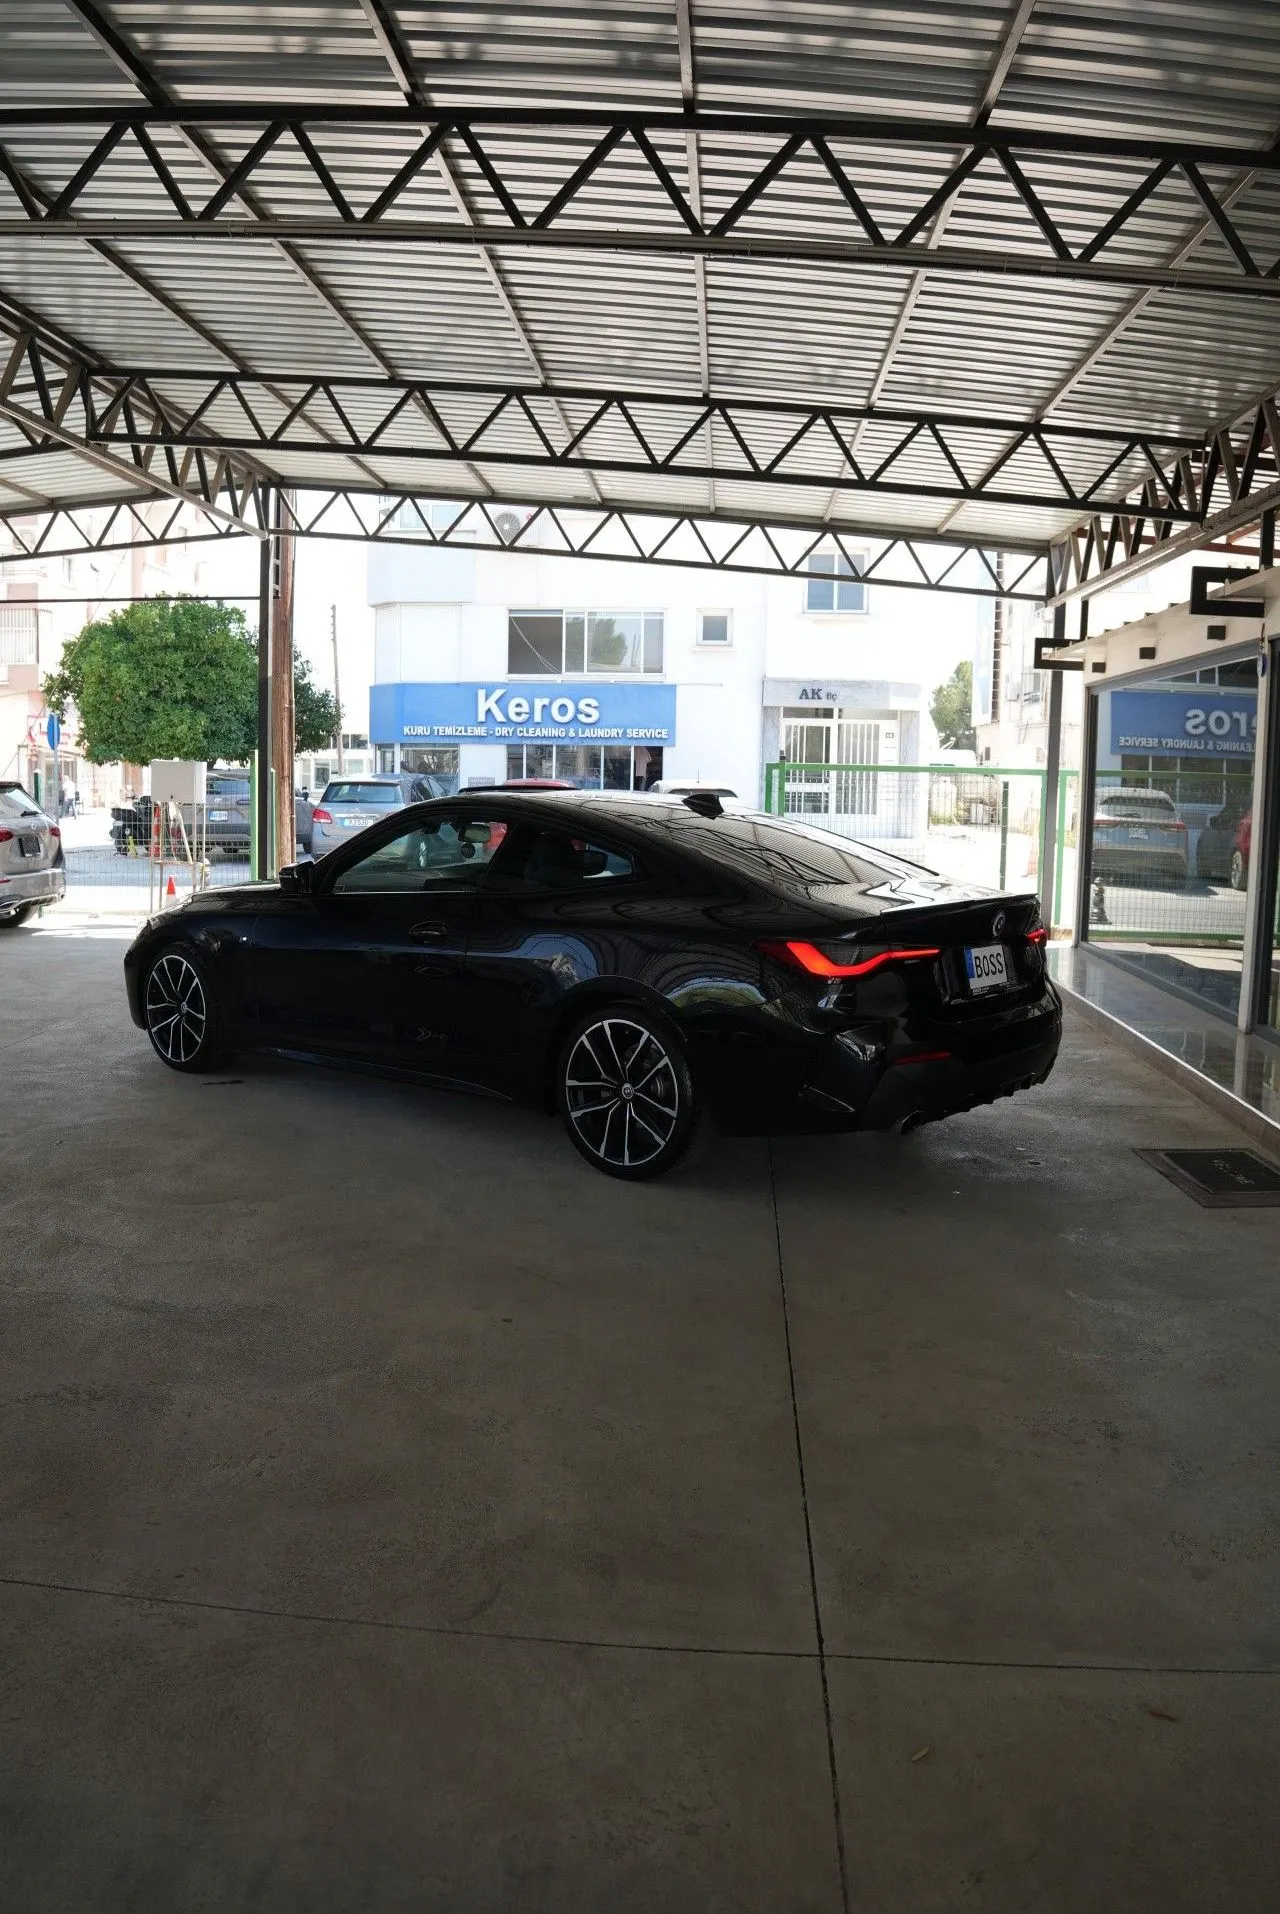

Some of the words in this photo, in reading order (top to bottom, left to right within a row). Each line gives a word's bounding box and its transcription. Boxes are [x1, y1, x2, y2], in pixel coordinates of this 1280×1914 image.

[799, 688, 822, 700] AK
[477, 688, 600, 723] Keros
[403, 725, 430, 736] KURU
[433, 725, 488, 737] TEMİZLEME
[495, 727, 515, 737] DRY
[517, 727, 566, 738] CLEANING
[568, 728, 576, 738] &
[578, 728, 624, 738] LAUNDRY
[626, 728, 669, 739] SERVICE
[975, 953, 1004, 978] BOSS
